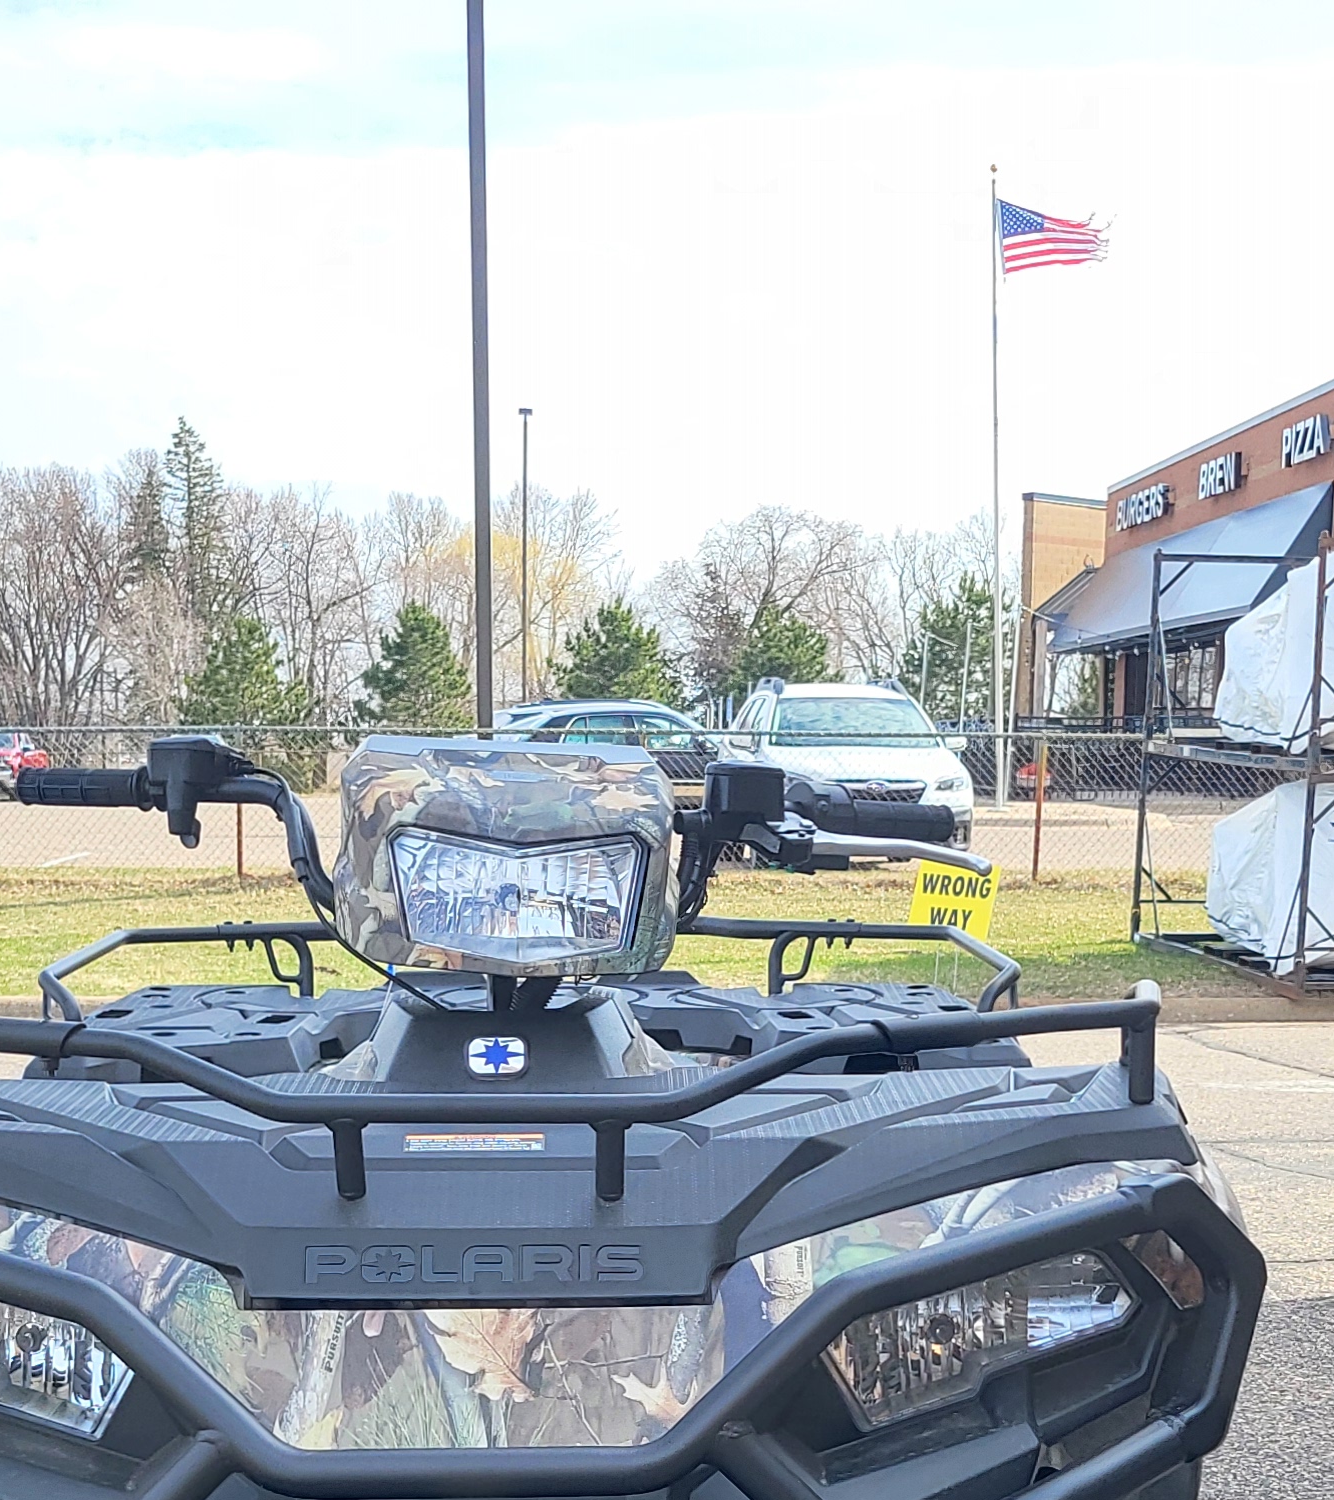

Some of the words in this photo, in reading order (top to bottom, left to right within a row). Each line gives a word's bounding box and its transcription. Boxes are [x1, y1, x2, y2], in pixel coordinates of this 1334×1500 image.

[1281, 413, 1327, 469] PIZZA
[1198, 451, 1239, 500] BREW
[1116, 483, 1168, 532] BURGERS
[922, 872, 993, 899] WRONG
[930, 906, 973, 931] WAY
[304, 1243, 646, 1284] POLARIS
[324, 1312, 345, 1373] PURSUIT
